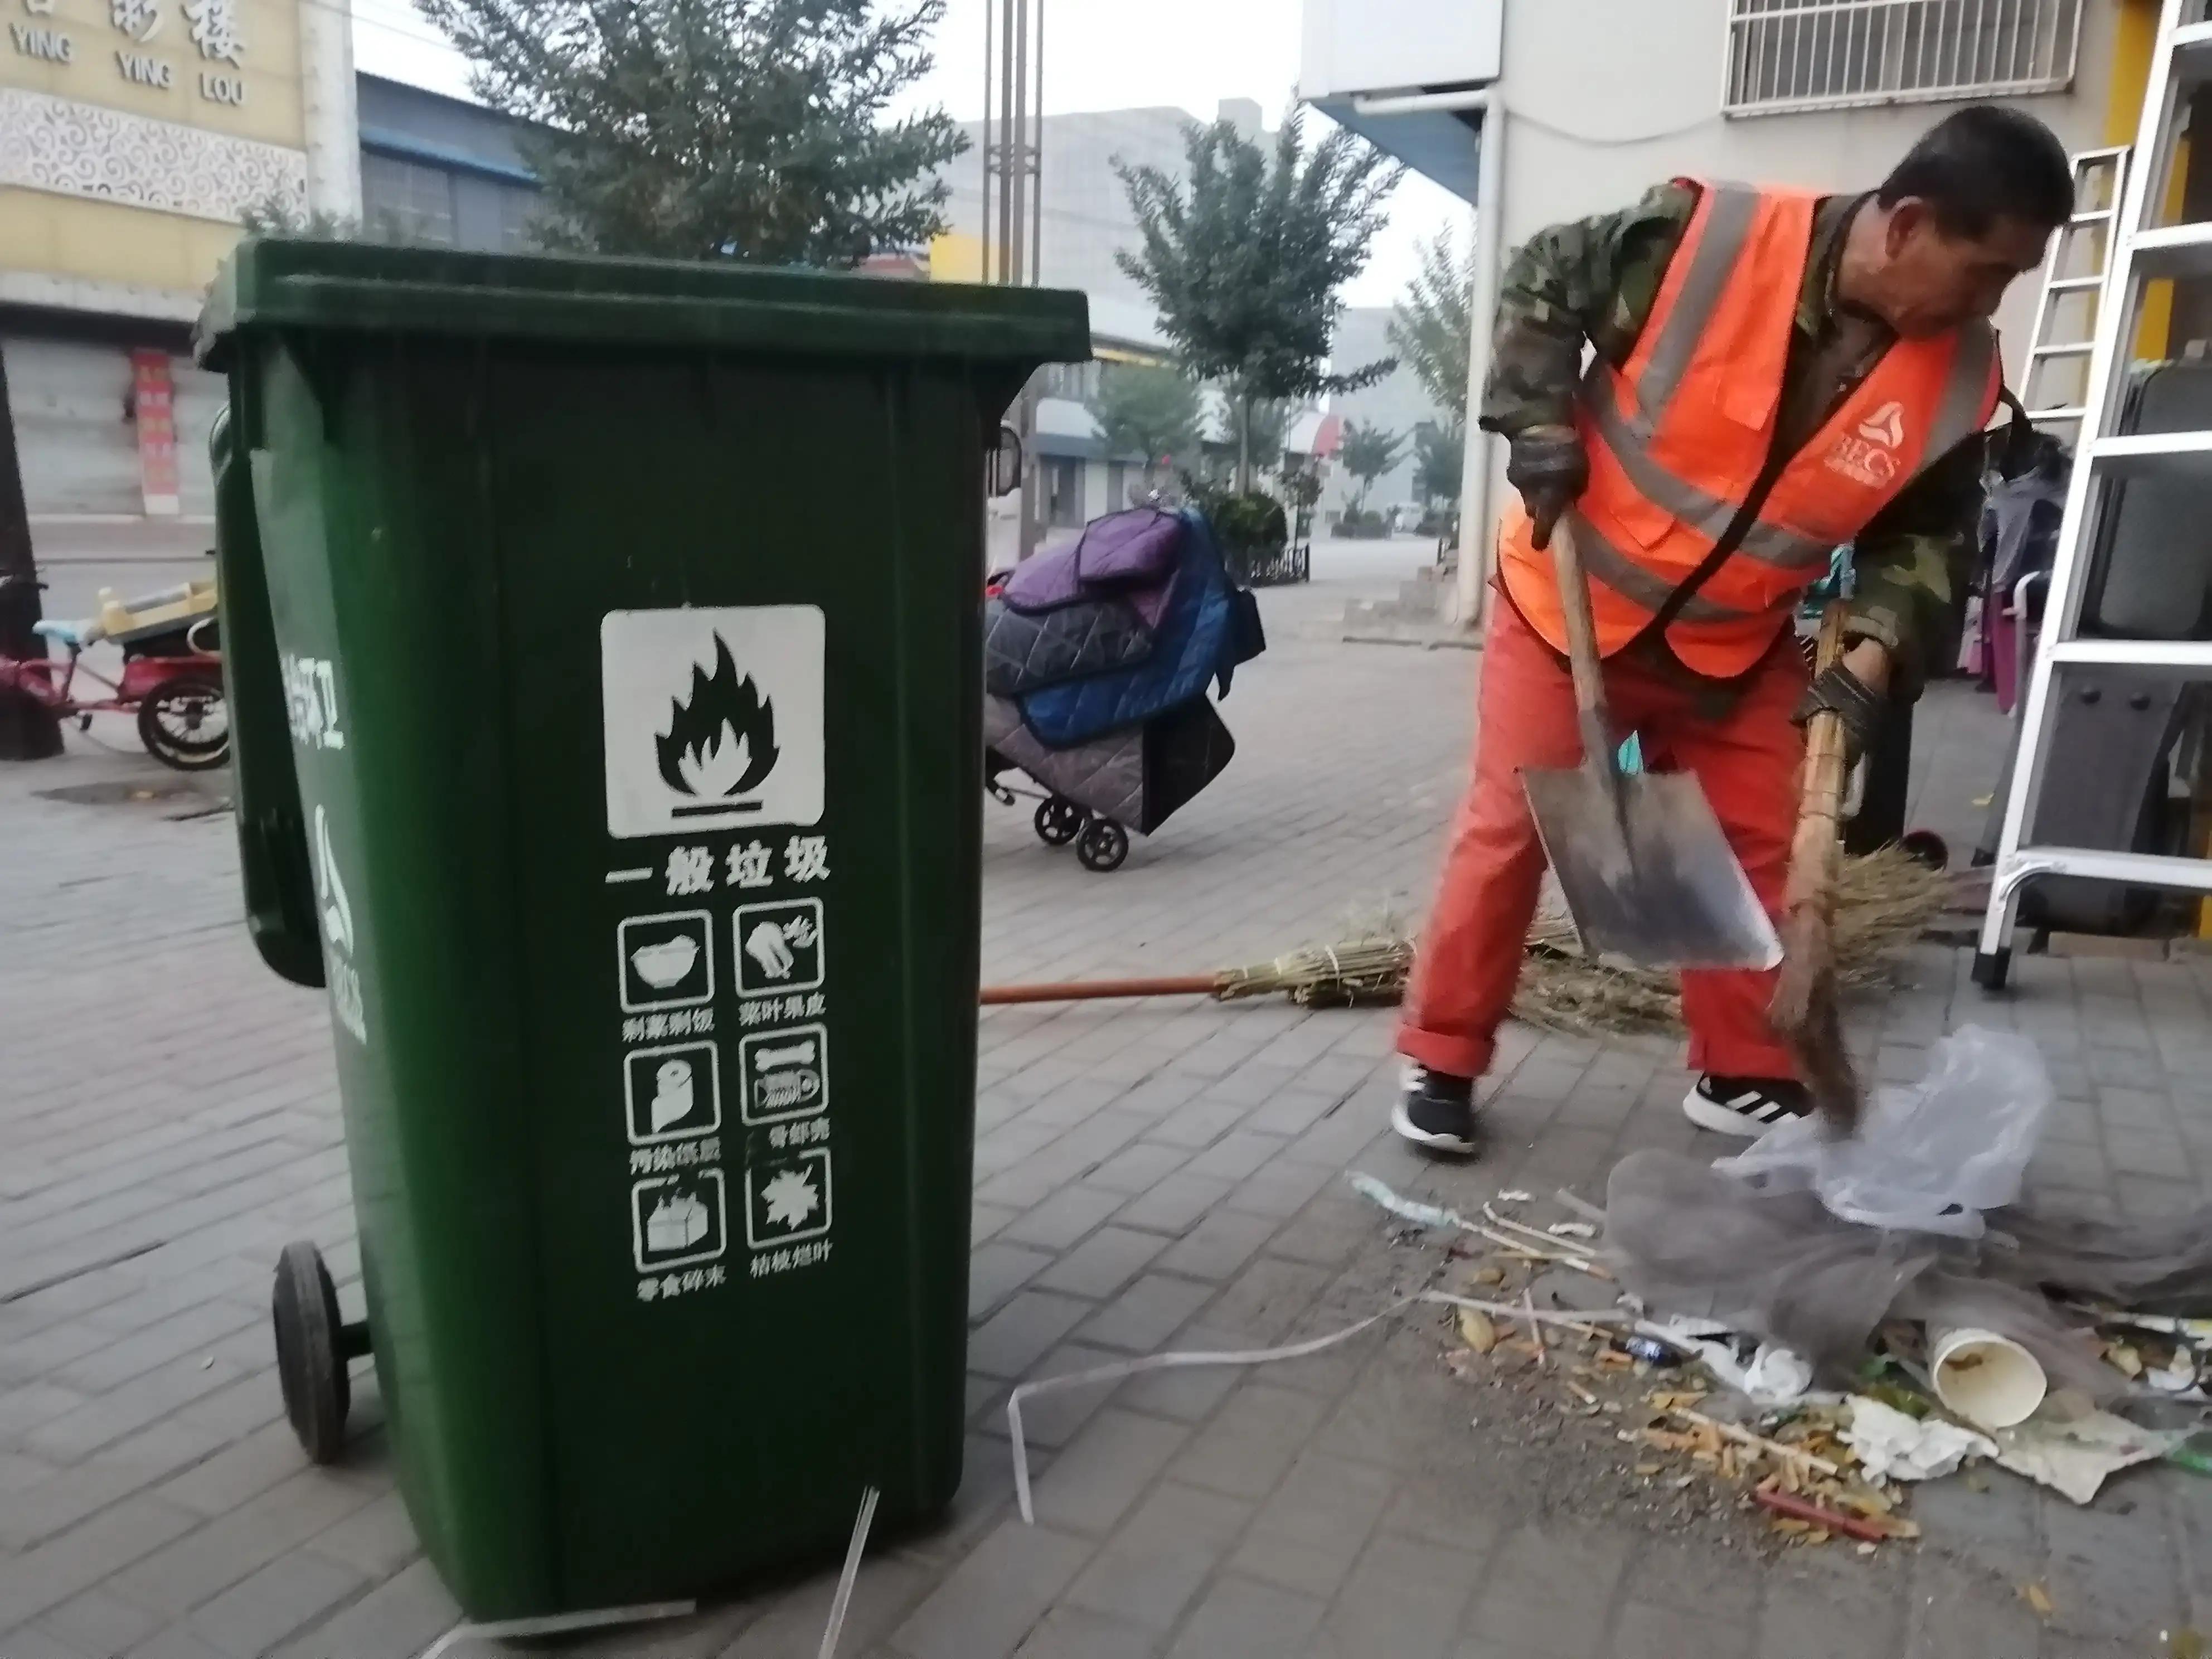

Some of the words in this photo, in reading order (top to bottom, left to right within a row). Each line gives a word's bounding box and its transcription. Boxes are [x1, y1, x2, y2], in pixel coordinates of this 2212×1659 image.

[10, 23, 72, 62] YING
[116, 50, 173, 89] YING
[200, 72, 244, 105] LOU
[605, 836, 831, 895] 一般垃圾
